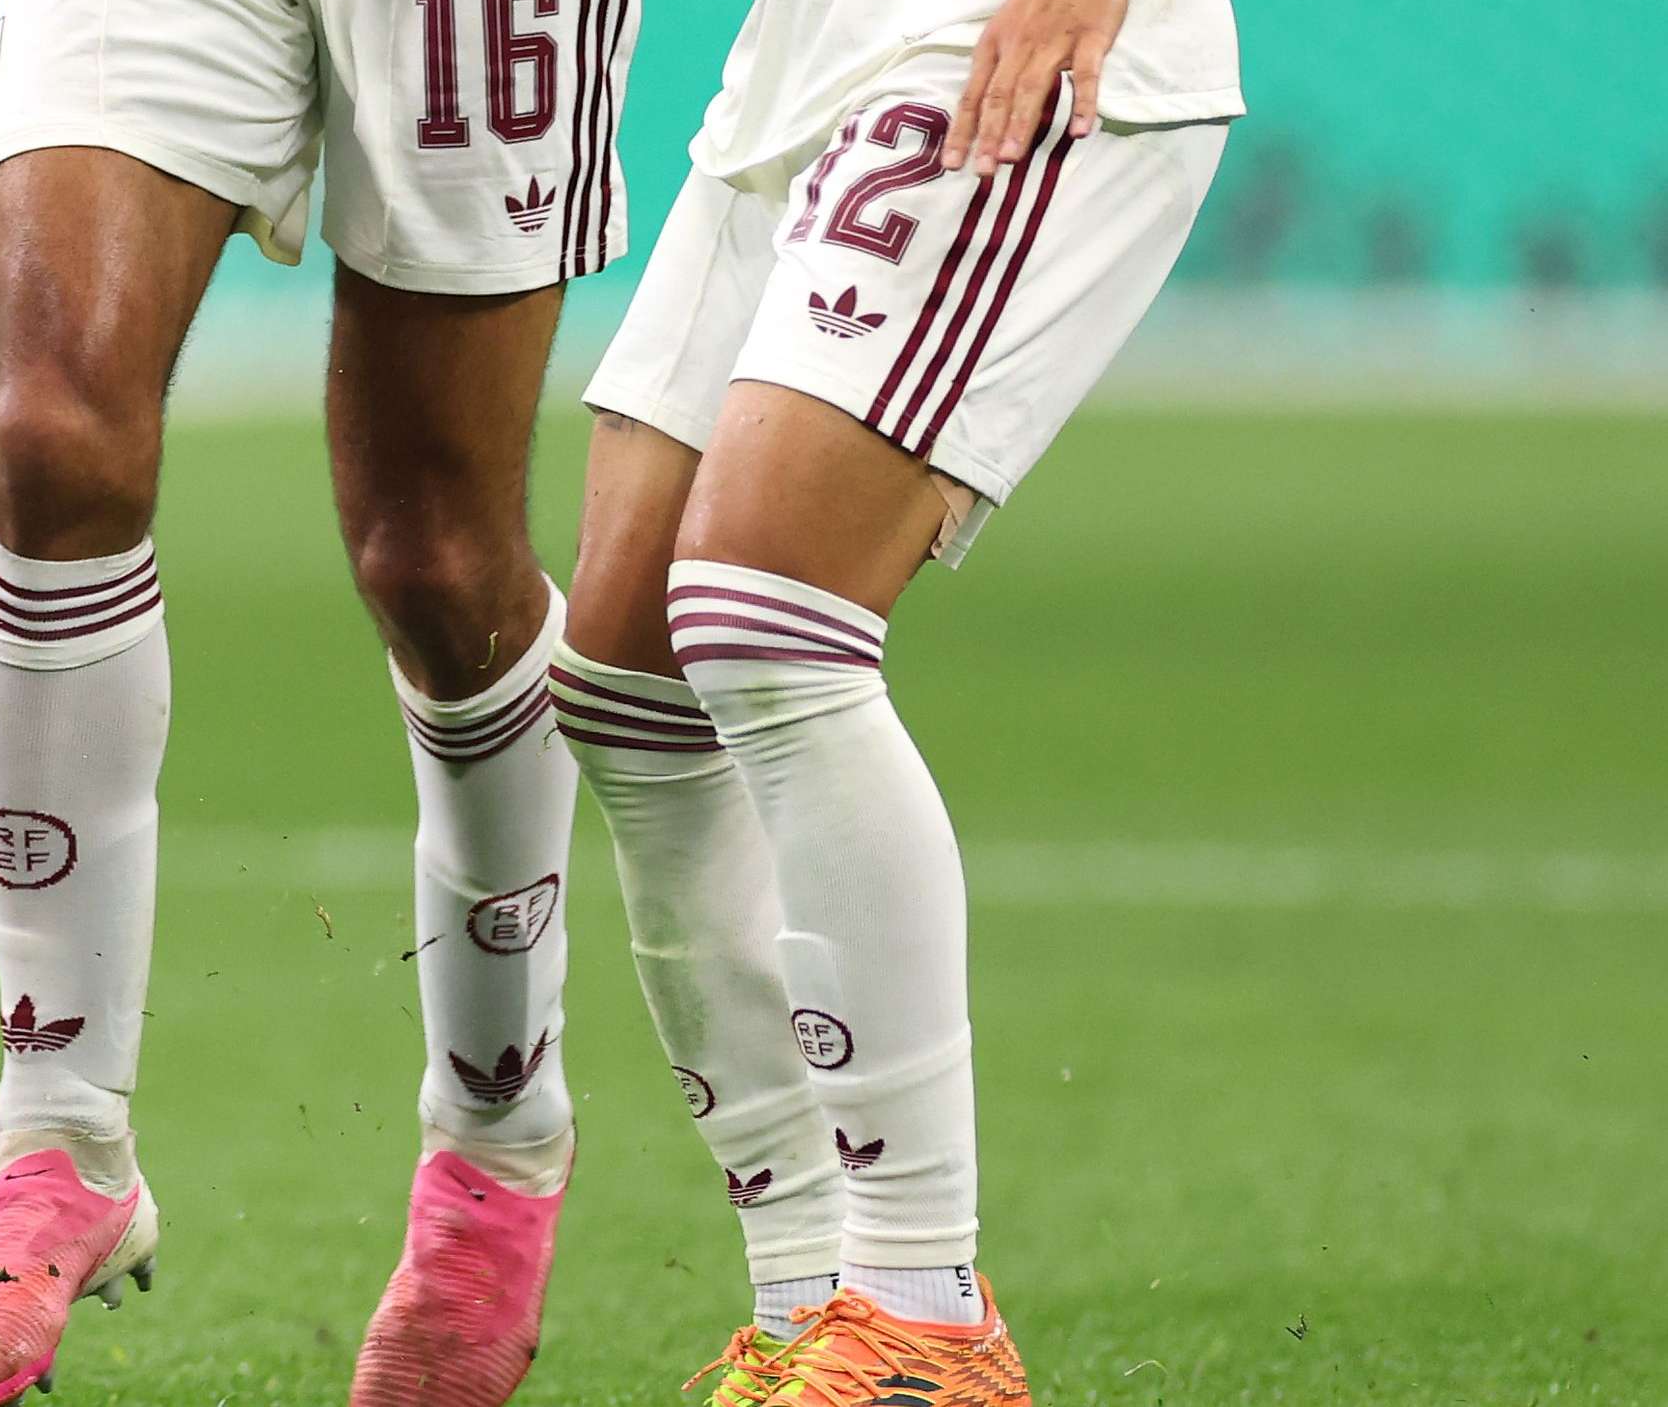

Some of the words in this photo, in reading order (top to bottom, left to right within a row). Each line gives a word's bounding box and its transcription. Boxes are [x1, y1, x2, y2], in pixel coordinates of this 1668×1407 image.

[781, 100, 952, 266] 12
[493, 889, 547, 921] RF
[491, 909, 544, 940] EF
[797, 1022, 831, 1038] RF
[802, 1039, 834, 1057] EF
